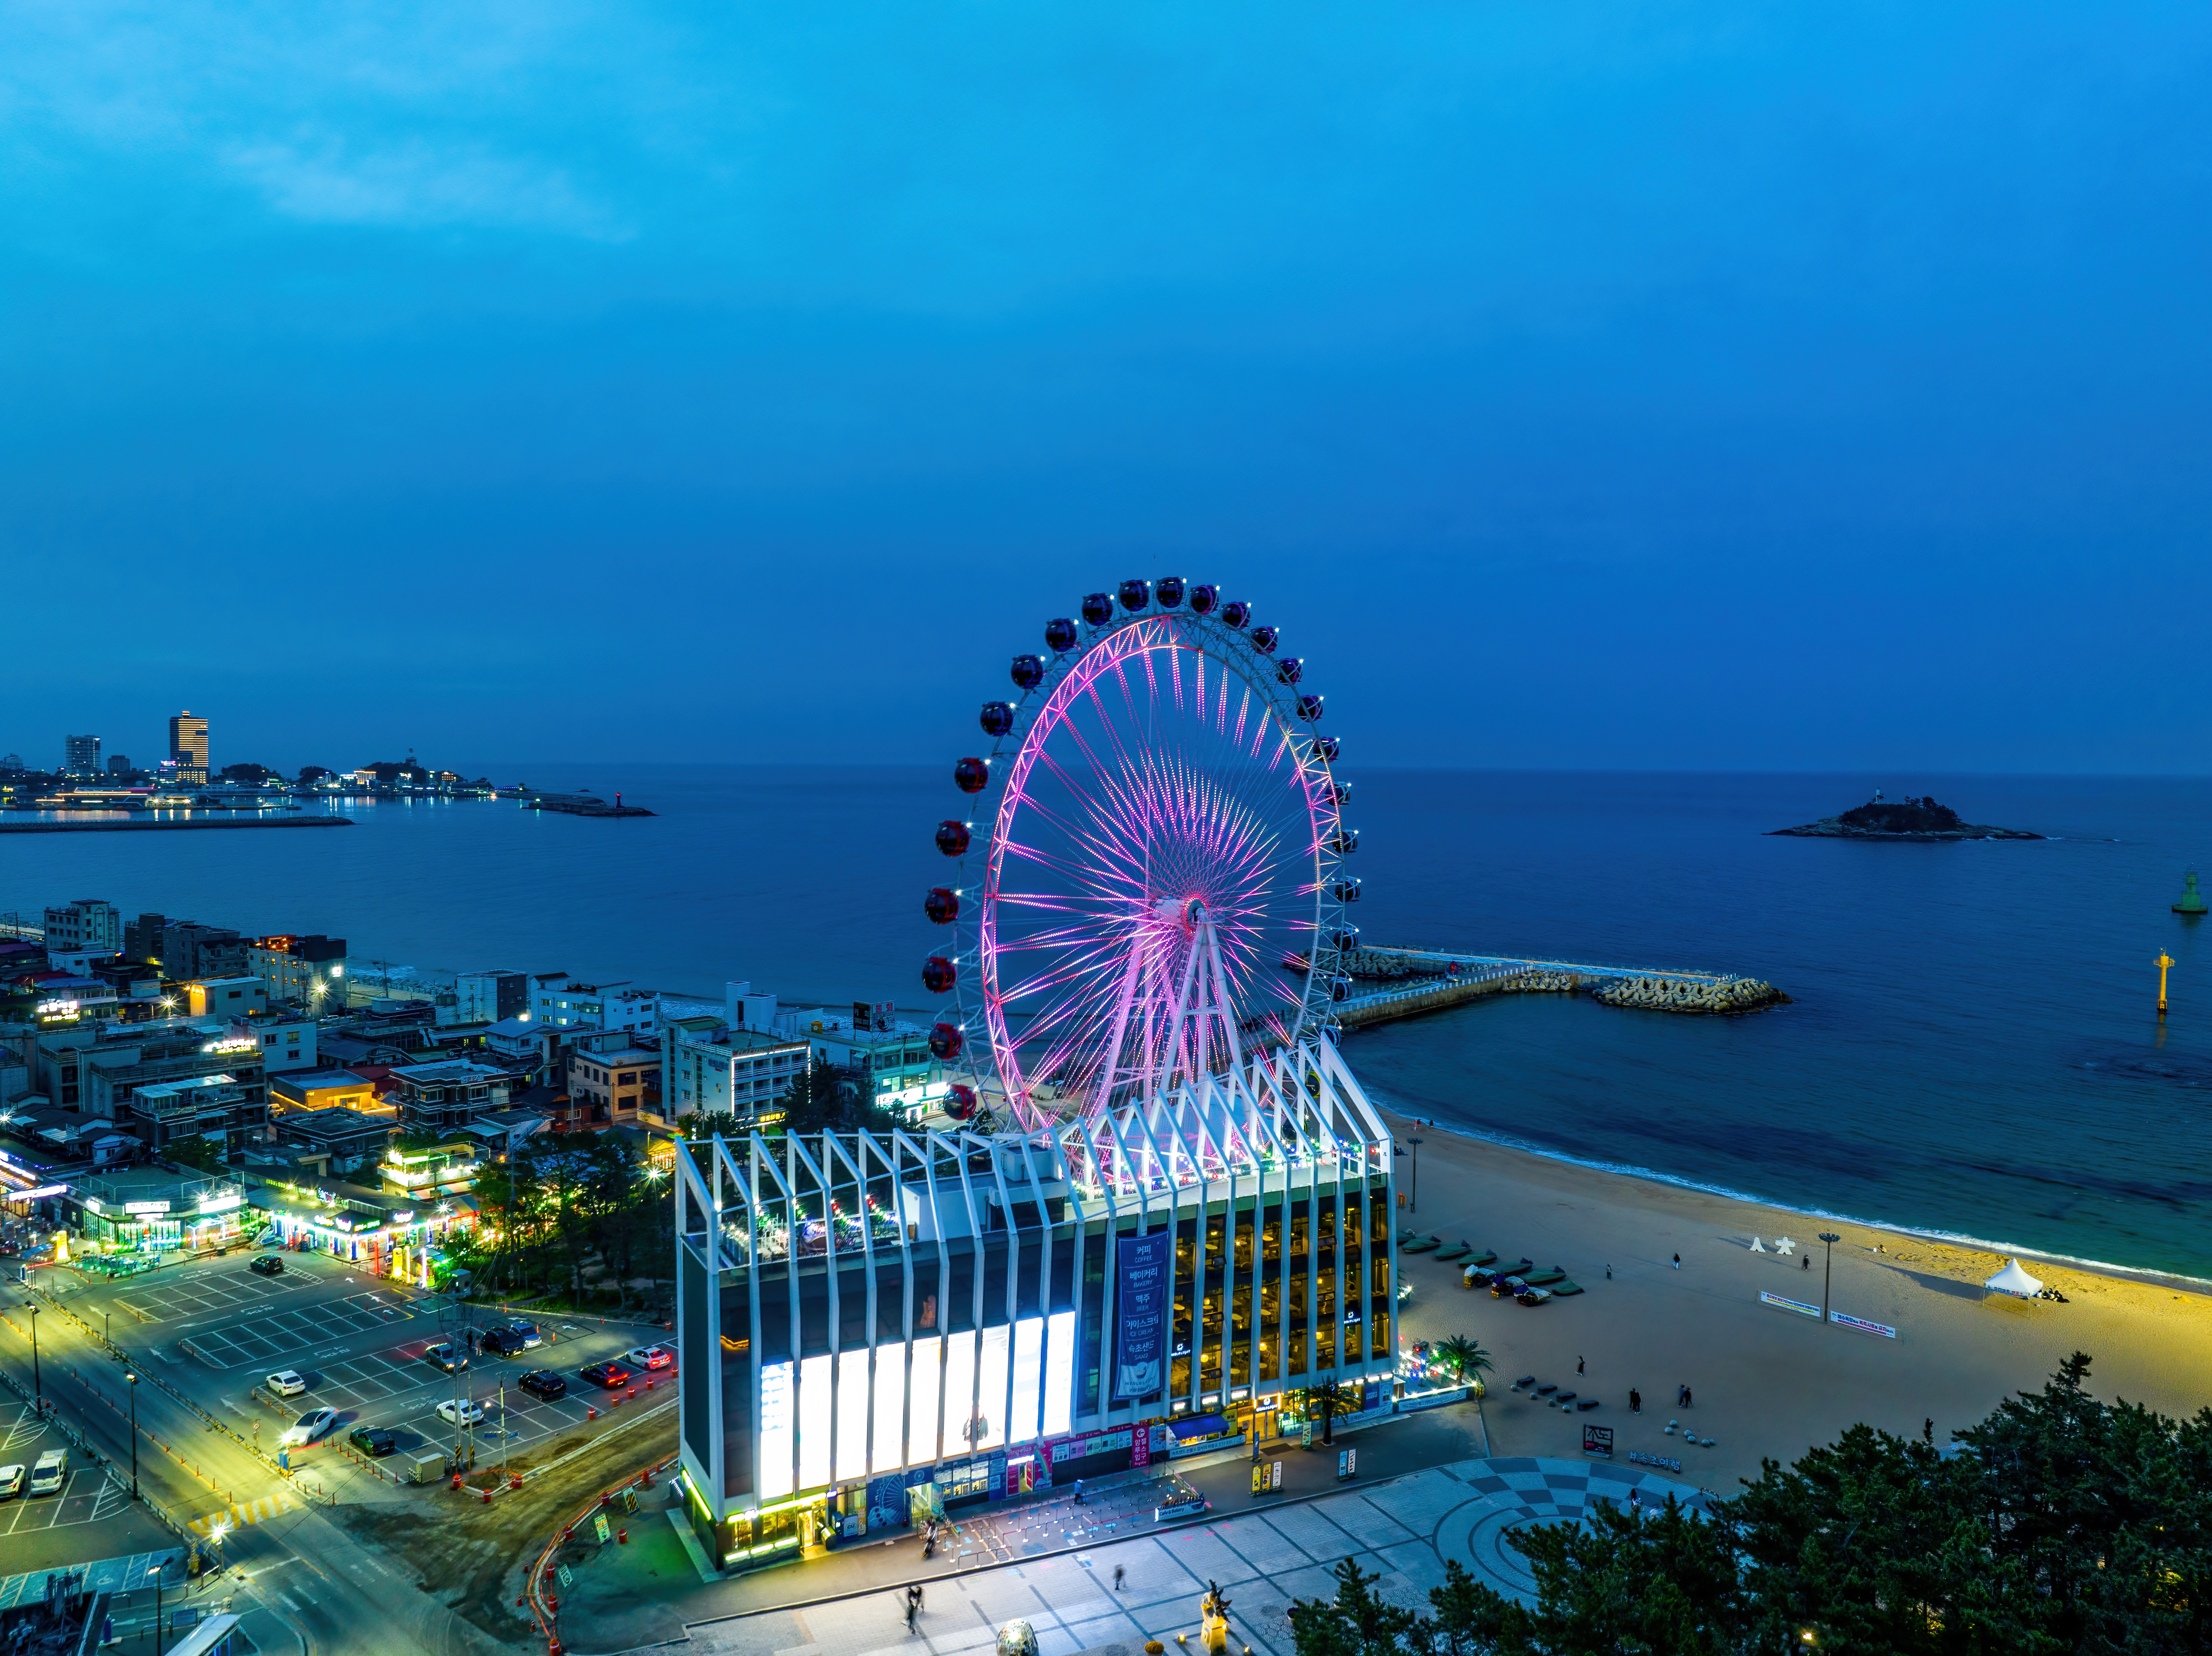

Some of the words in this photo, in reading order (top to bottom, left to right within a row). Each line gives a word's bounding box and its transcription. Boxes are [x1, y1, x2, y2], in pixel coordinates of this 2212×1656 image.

[1137, 1245, 1151, 1255] 커피
[1135, 1255, 1153, 1263] COFFEE
[1130, 1267, 1158, 1281] 베이커리
[1136, 1294, 1150, 1304] 맥주
[1126, 1314, 1158, 1330] 아이스크림
[1135, 1438, 1146, 1446] 앙젤
